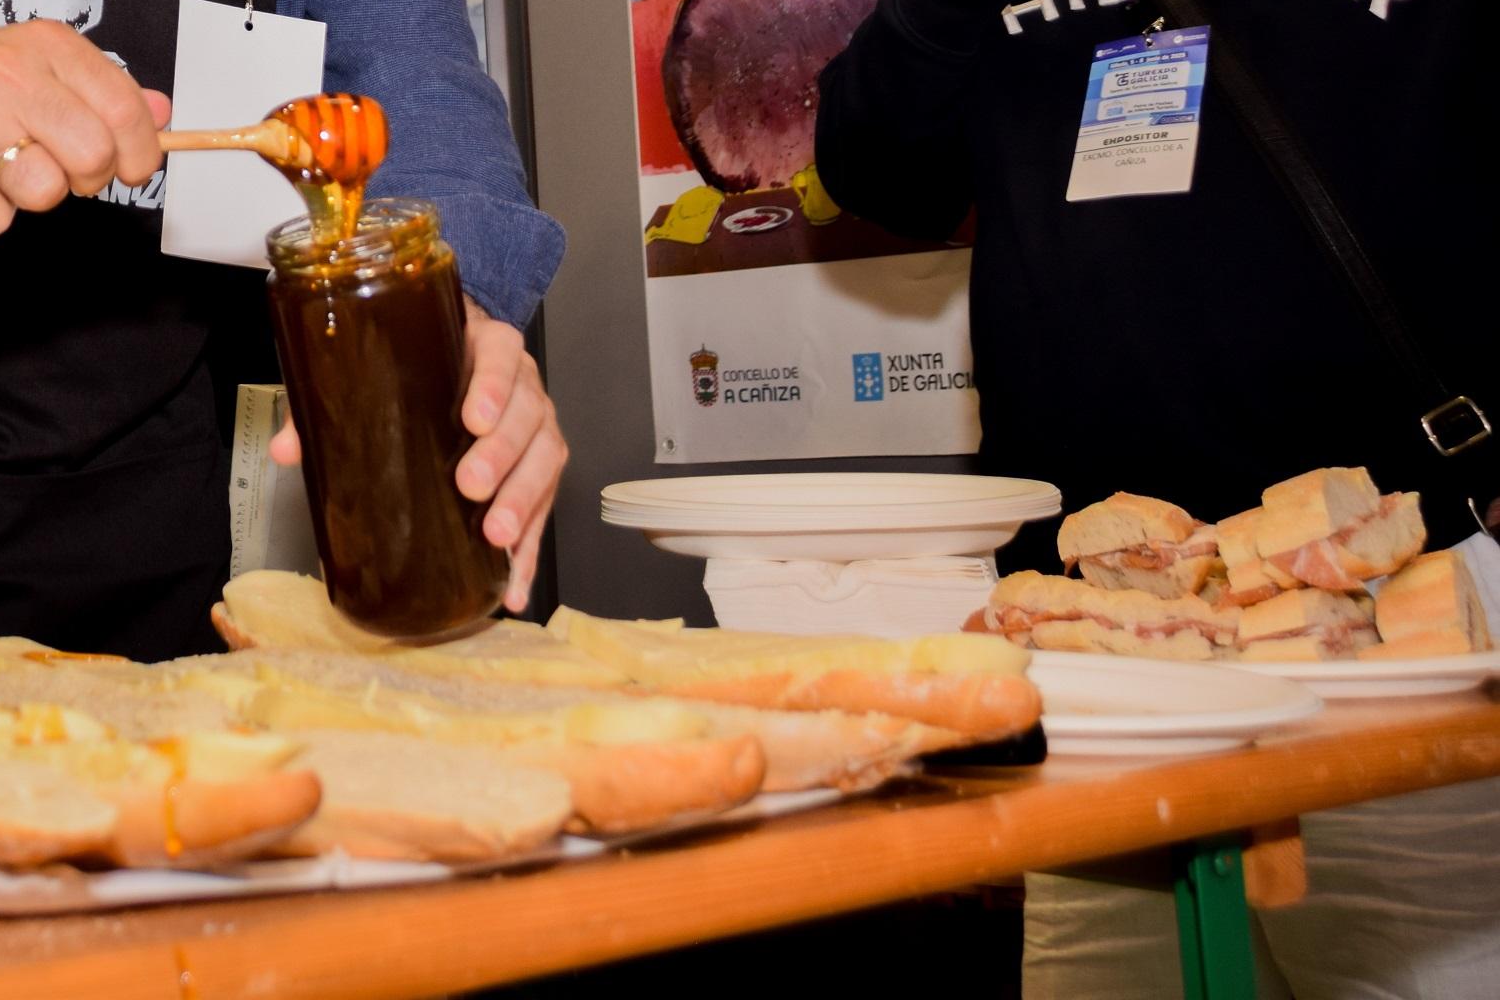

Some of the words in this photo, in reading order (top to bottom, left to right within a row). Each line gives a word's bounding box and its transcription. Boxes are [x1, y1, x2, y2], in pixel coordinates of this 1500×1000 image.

[887, 352, 944, 372] XUNTA
[722, 367, 780, 383] CONCELLO
[782, 366, 799, 380] DE
[889, 375, 909, 392] DE
[913, 372, 975, 391] GALICI
[724, 389, 736, 403] A
[739, 383, 801, 403] CAÑIZA
